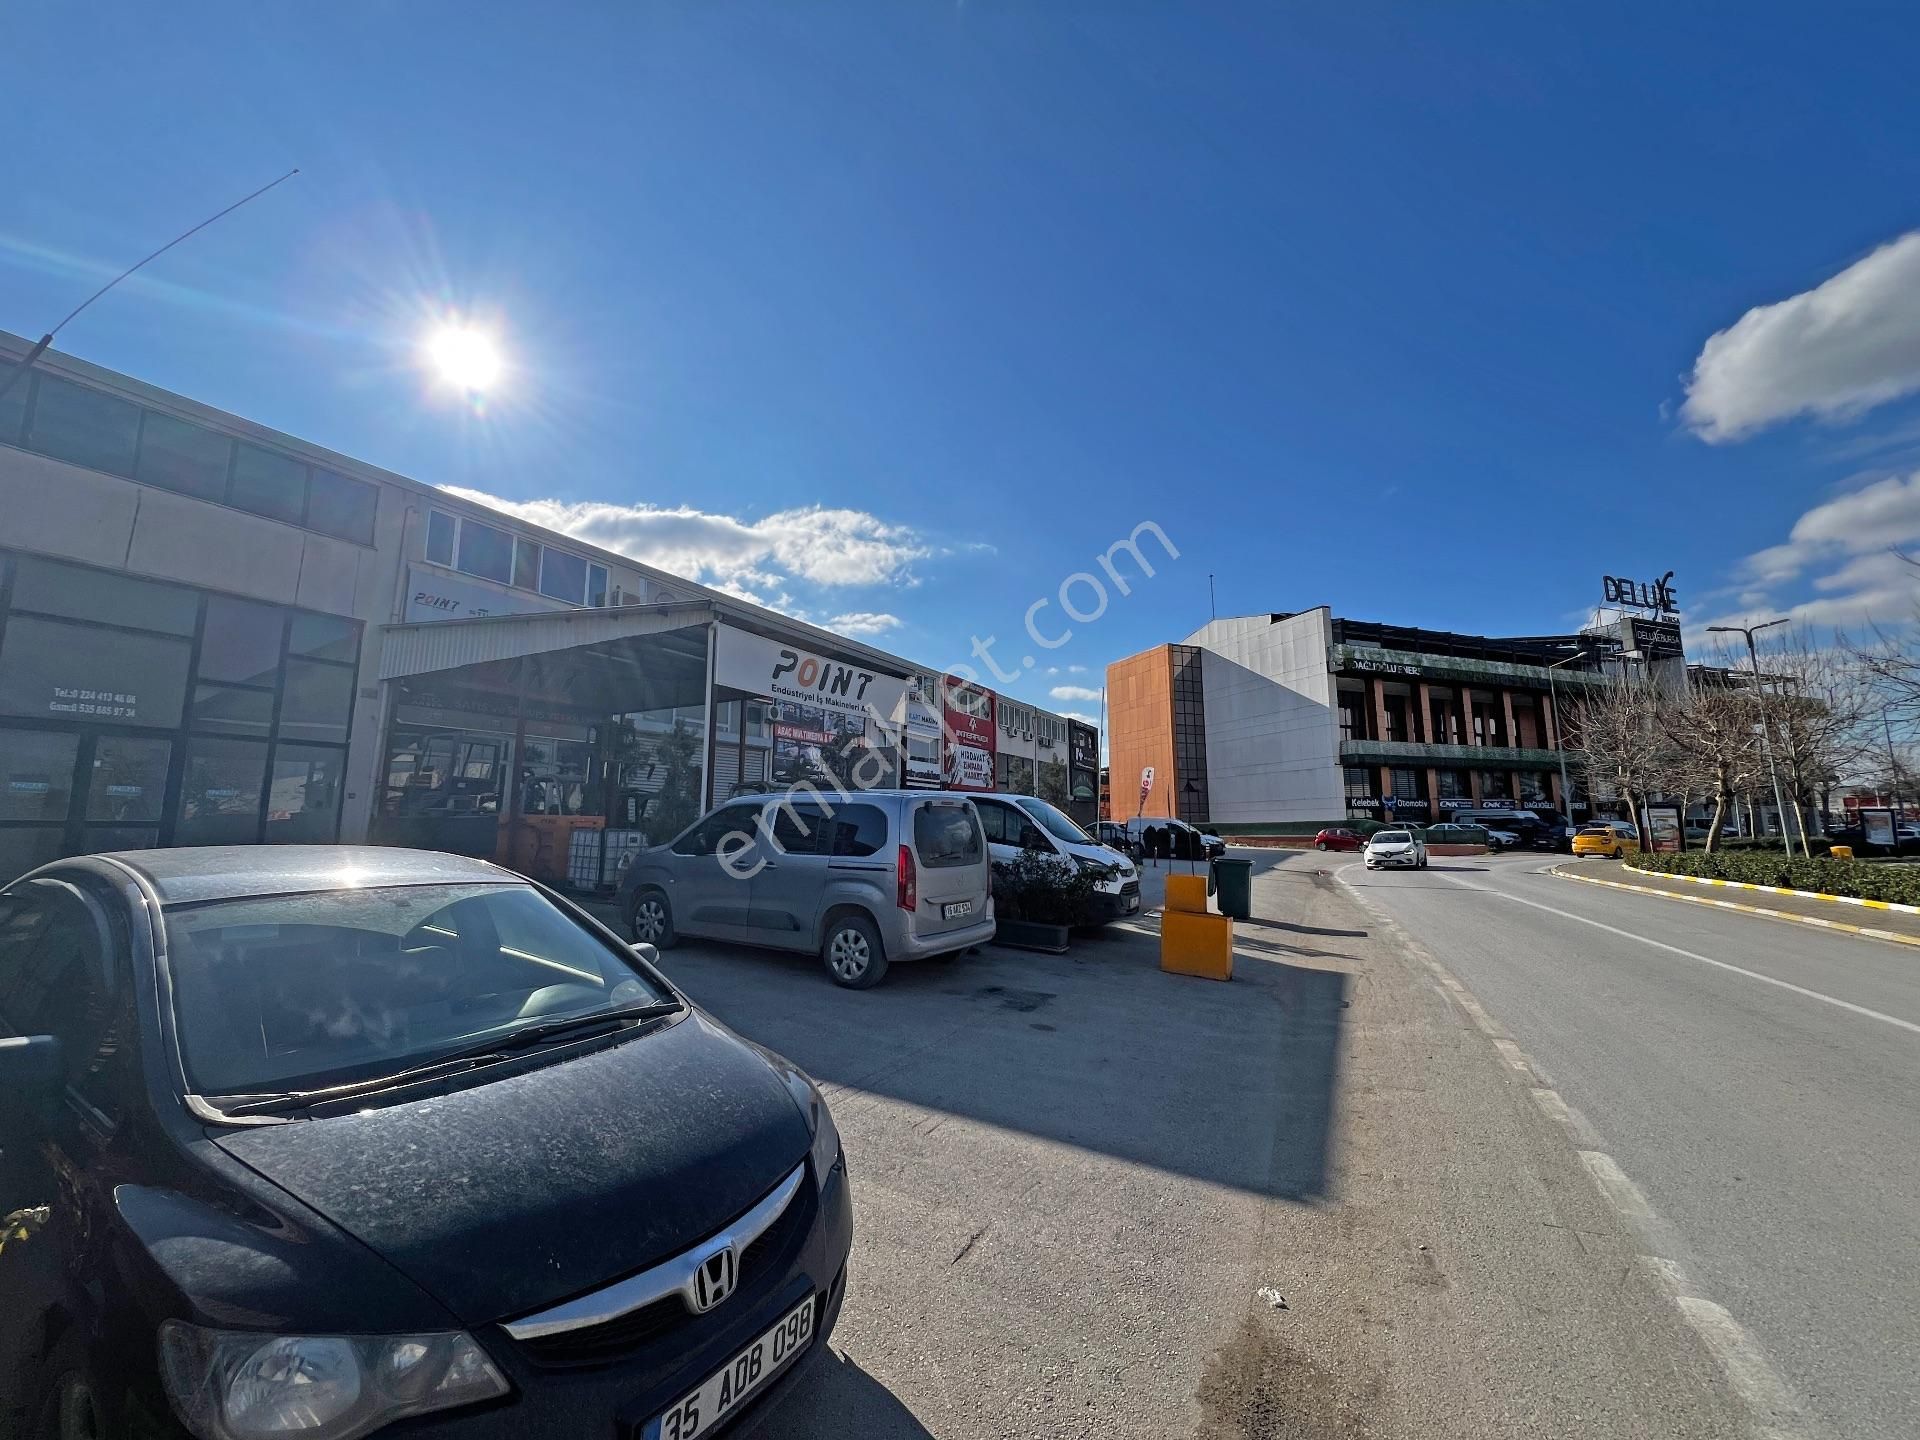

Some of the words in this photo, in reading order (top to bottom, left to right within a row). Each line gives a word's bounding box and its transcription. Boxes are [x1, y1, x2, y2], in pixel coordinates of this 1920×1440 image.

[414, 592, 460, 610] POINT
[1603, 571, 1681, 621] DELUXE
[772, 650, 873, 700] POINT
[771, 683, 815, 702] Endüstriyel
[825, 697, 860, 712] Makineleri
[1351, 798, 1380, 807] Kelebek
[1397, 799, 1428, 808] Otomotiv
[665, 1392, 700, 1440] 35
[772, 1302, 811, 1363] 098
